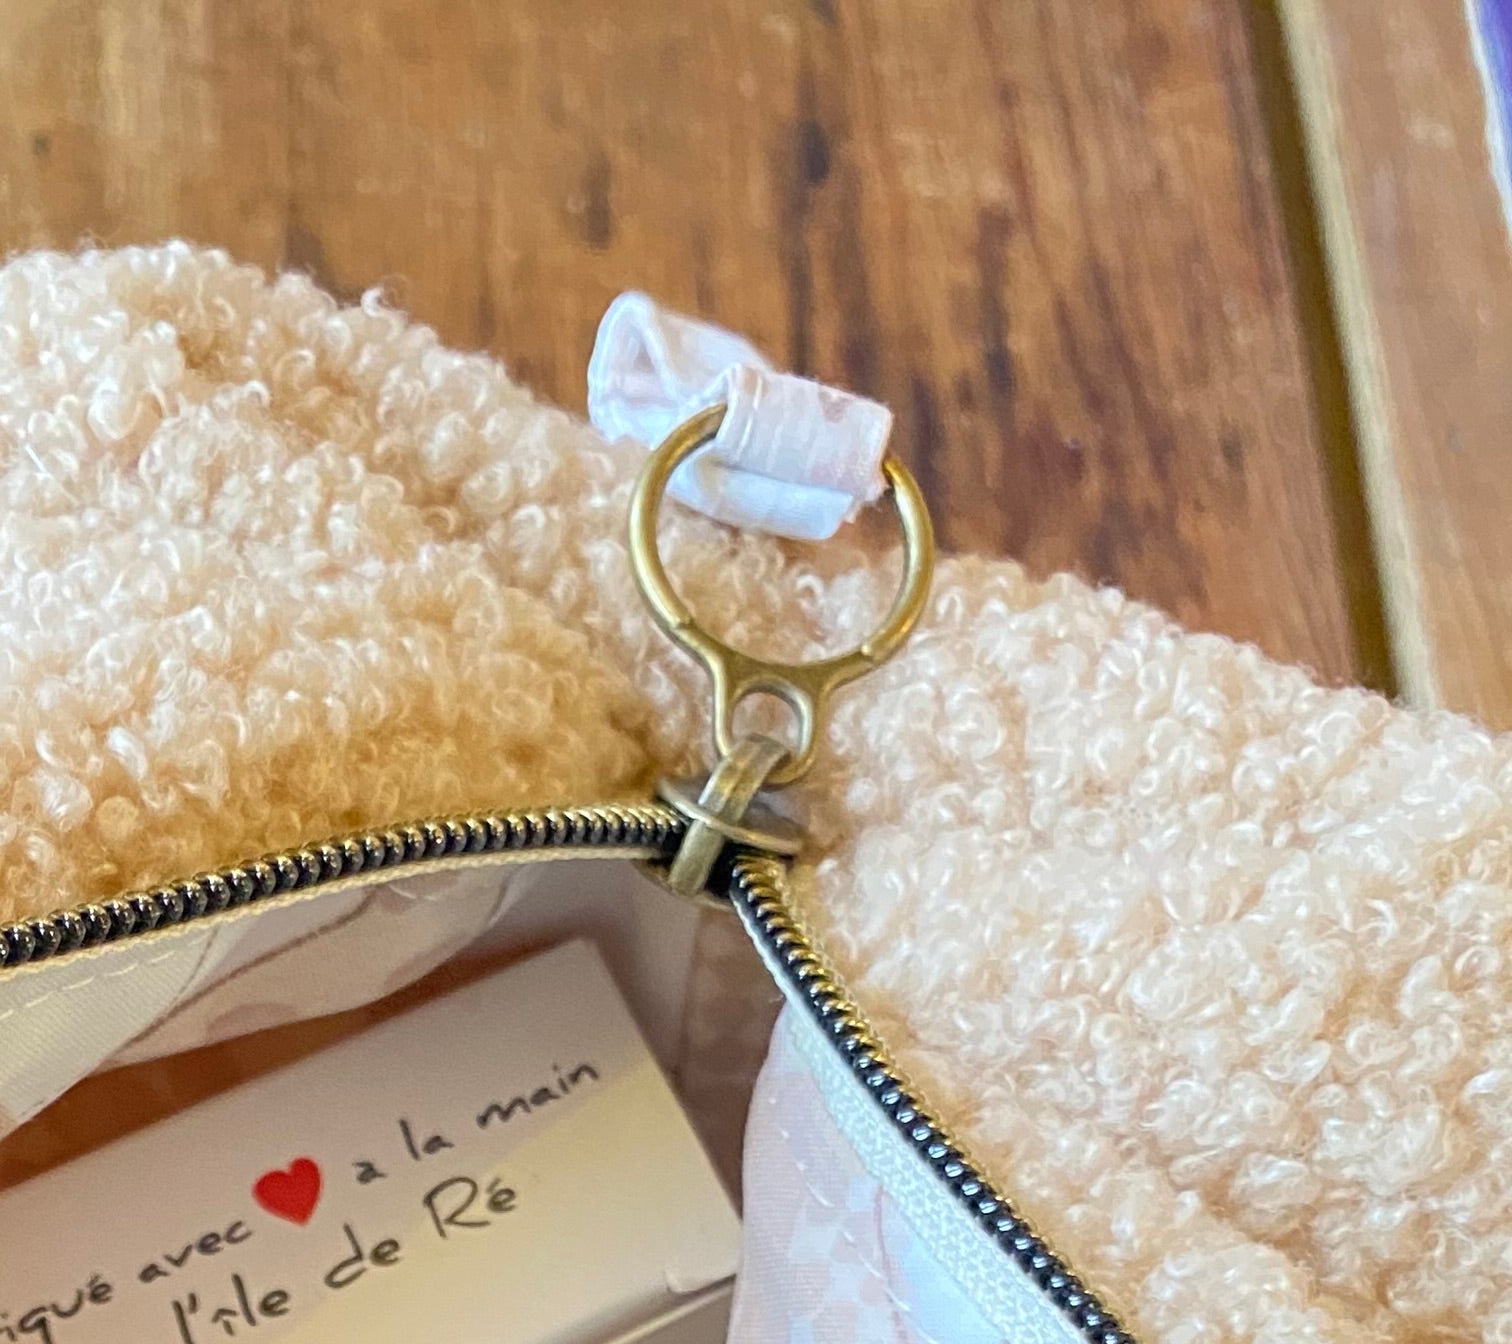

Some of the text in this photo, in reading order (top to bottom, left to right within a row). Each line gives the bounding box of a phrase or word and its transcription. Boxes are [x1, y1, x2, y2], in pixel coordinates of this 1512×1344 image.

[138, 1220, 253, 1284] avec
[398, 1118, 455, 1161] la
[476, 1063, 599, 1130] main
[324, 1222, 400, 1289] de
[422, 1177, 517, 1239] Ré
